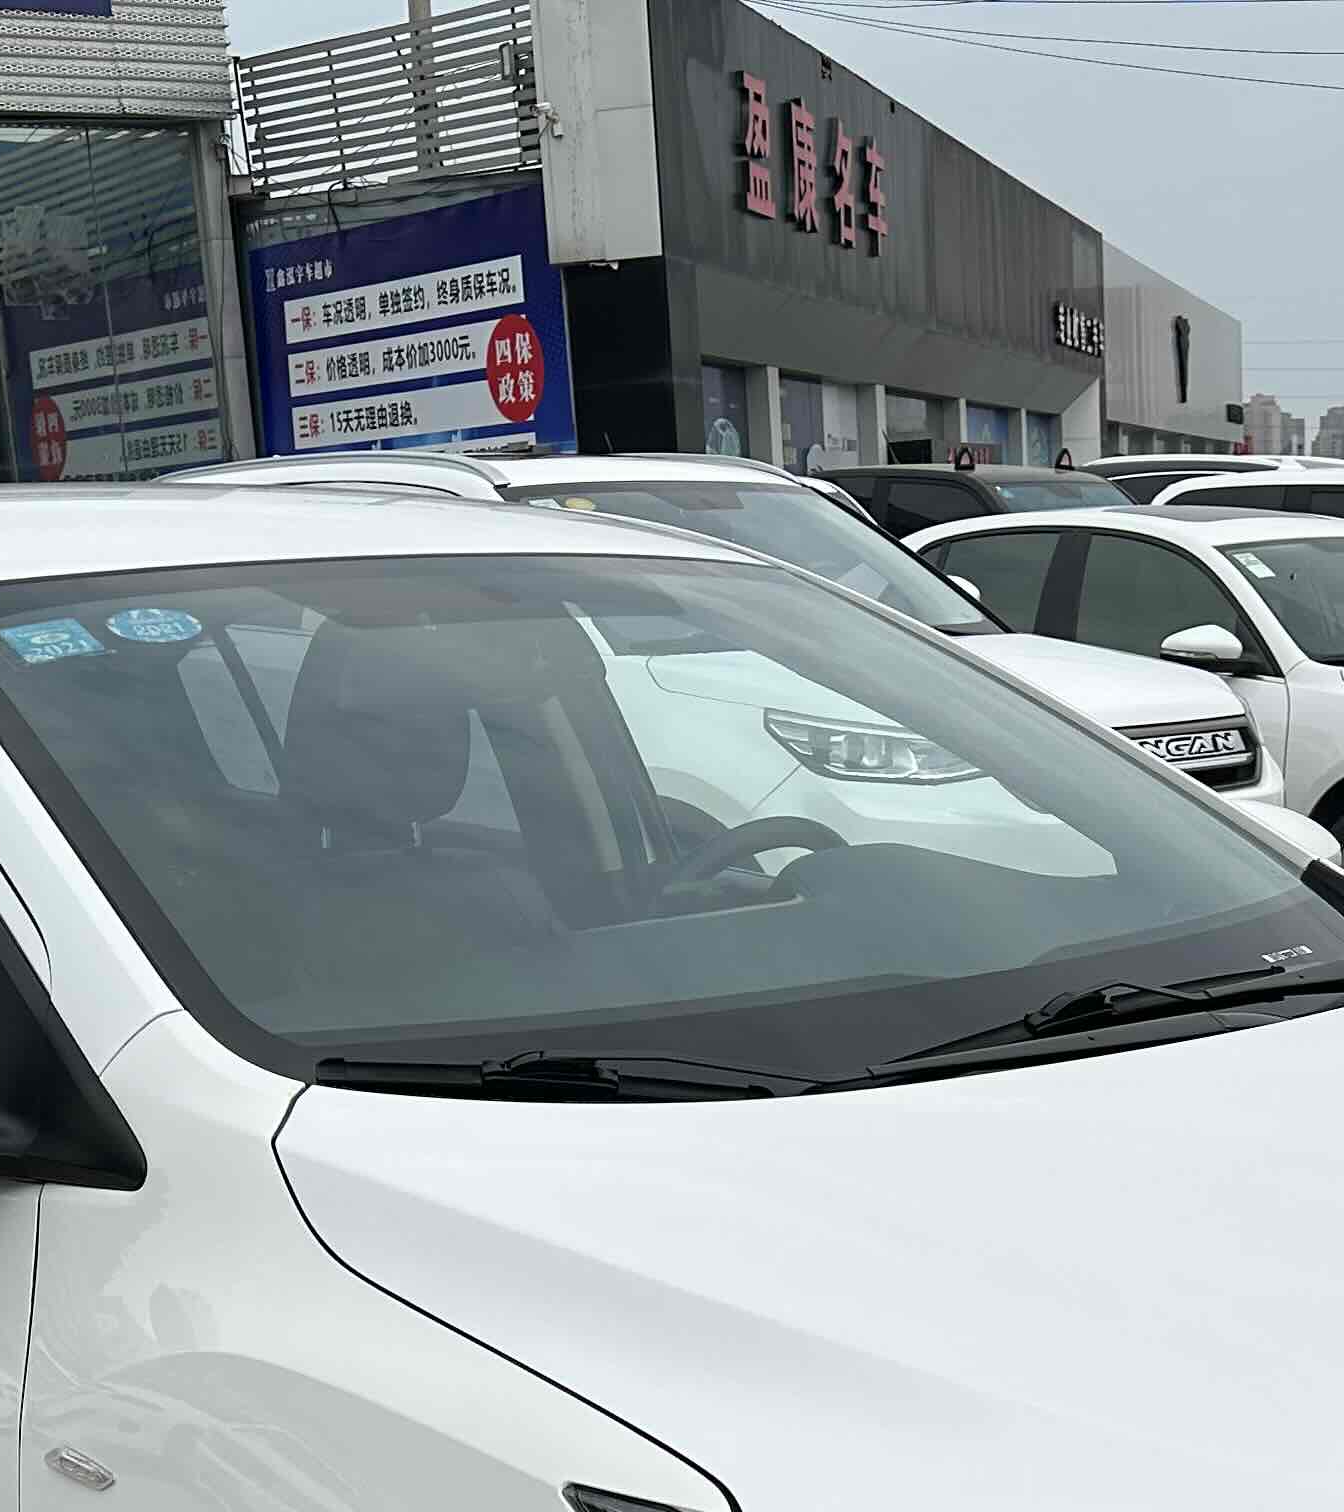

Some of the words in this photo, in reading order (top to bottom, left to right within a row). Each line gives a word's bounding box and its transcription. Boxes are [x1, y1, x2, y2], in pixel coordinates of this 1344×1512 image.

[740, 71, 888, 257] 盈康名车
[495, 332, 533, 365] 四保
[498, 370, 536, 404] 政策
